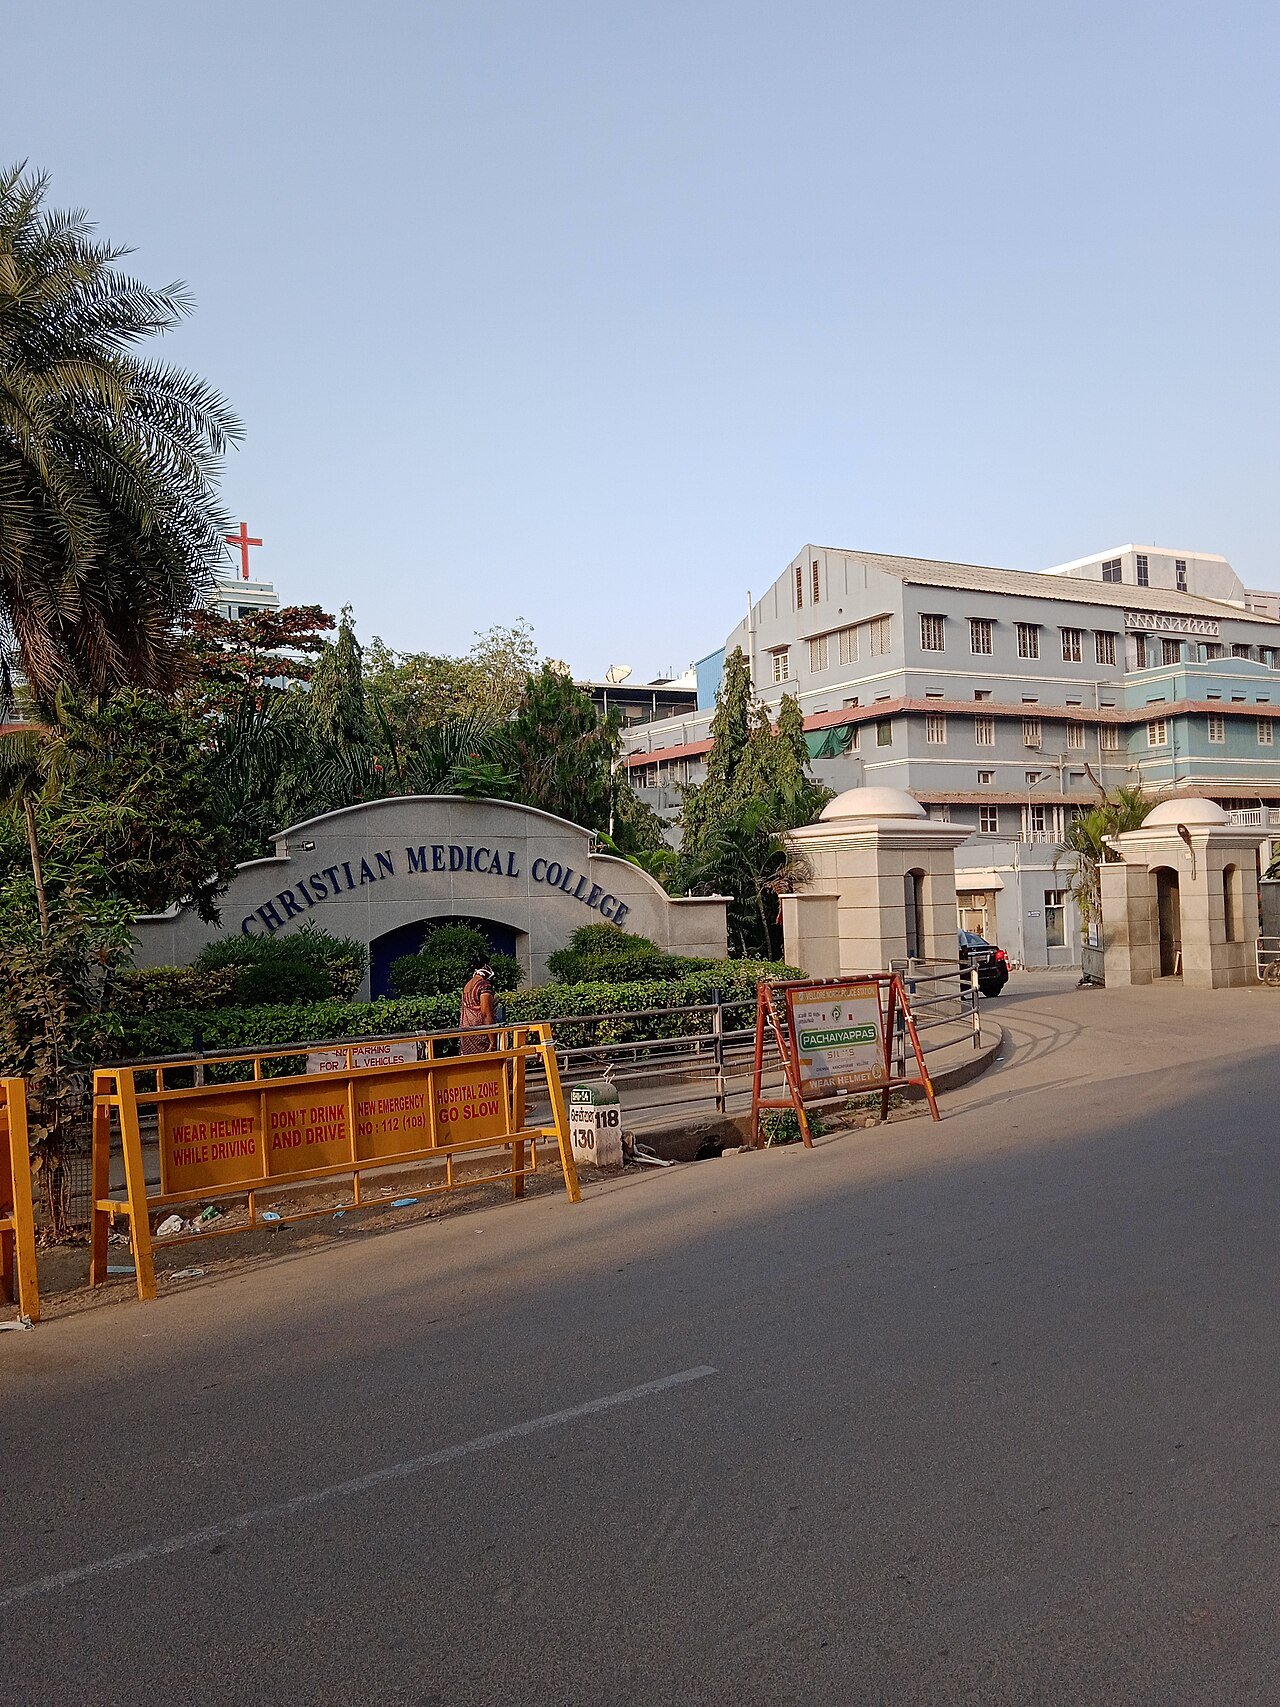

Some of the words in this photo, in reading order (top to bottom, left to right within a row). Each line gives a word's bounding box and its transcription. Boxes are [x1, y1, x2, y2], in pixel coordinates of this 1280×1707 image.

[241, 849, 395, 936] CHRISTIAN
[405, 844, 520, 878] MEDICAL
[531, 857, 630, 926] COLLEGE
[803, 1028, 875, 1045] PACHAIYAPPAS
[335, 1049, 348, 1057] NO
[352, 1045, 391, 1056] PARKING
[827, 1048, 855, 1059] SILS
[320, 1061, 339, 1071] FOR
[343, 1059, 361, 1069] AL
[363, 1055, 405, 1067] VEHICLES
[809, 1077, 836, 1089] WEAR
[837, 1073, 871, 1085] HELMET
[437, 1086, 477, 1105] HOSPITAL
[478, 1081, 499, 1099] ZONE
[271, 1108, 307, 1130] DON'T
[310, 1104, 345, 1124] DRINK
[357, 1101, 376, 1117] NEW
[378, 1094, 425, 1114] EMERGENCY
[439, 1107, 459, 1124] GO
[463, 1100, 499, 1120] SLOW
[173, 1122, 208, 1144] WEAR
[210, 1117, 255, 1139] HELMET
[358, 1121, 373, 1136] NO
[381, 1117, 399, 1132] 112
[402, 1112, 426, 1132] (108)
[595, 1109, 619, 1129] 118
[272, 1130, 301, 1150] AND
[306, 1122, 346, 1145] DRIVE
[573, 1129, 595, 1150] 130
[173, 1145, 208, 1167] WHILE
[212, 1138, 256, 1161] DRIVING
